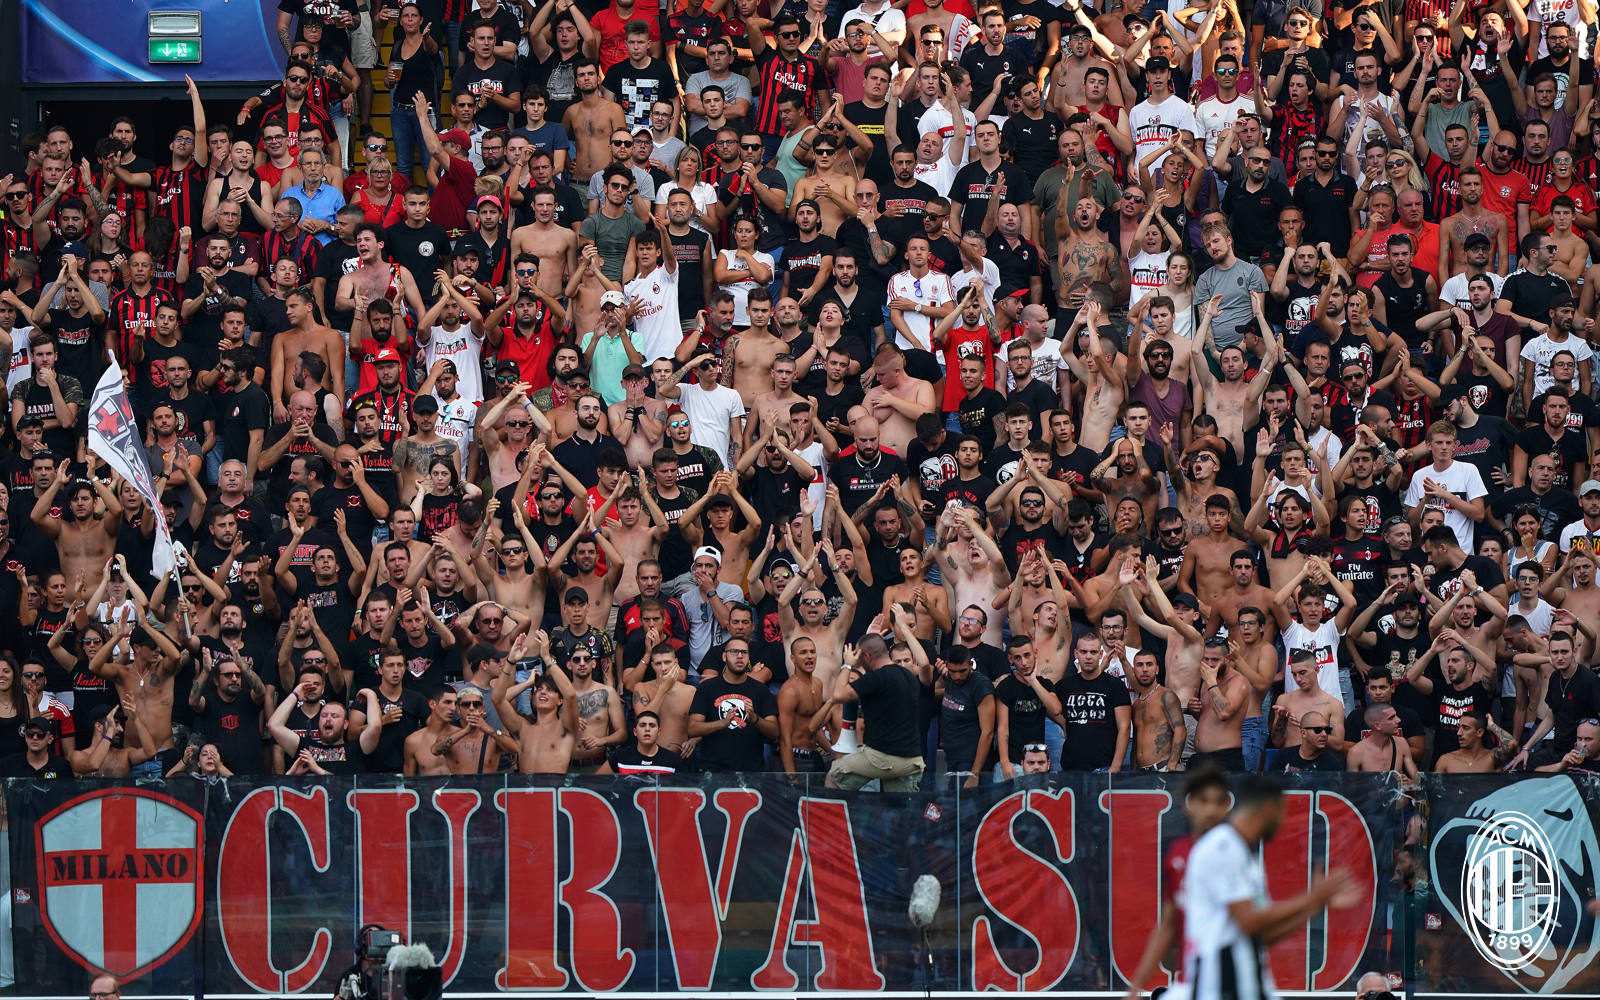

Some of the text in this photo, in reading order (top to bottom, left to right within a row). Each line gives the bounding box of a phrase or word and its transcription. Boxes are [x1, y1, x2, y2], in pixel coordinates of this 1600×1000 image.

[313, 7, 331, 15] NOI
[1541, 0, 1573, 12] #we
[1542, 11, 1565, 22] are
[687, 39, 699, 47] Fly
[775, 72, 807, 92] Emirates
[784, 73, 796, 82] Fly
[1136, 127, 1158, 142] CURVA
[1134, 271, 1157, 285] CURVA
[137, 312, 149, 320] Fly
[27, 403, 54, 414] BANDI
[383, 415, 396, 423] Fly
[676, 464, 704, 478] NDITI
[1348, 563, 1360, 571] Fly
[1337, 570, 1374, 581] Emirates
[51, 853, 188, 881] MILANO
[217, 785, 886, 994] CURVA
